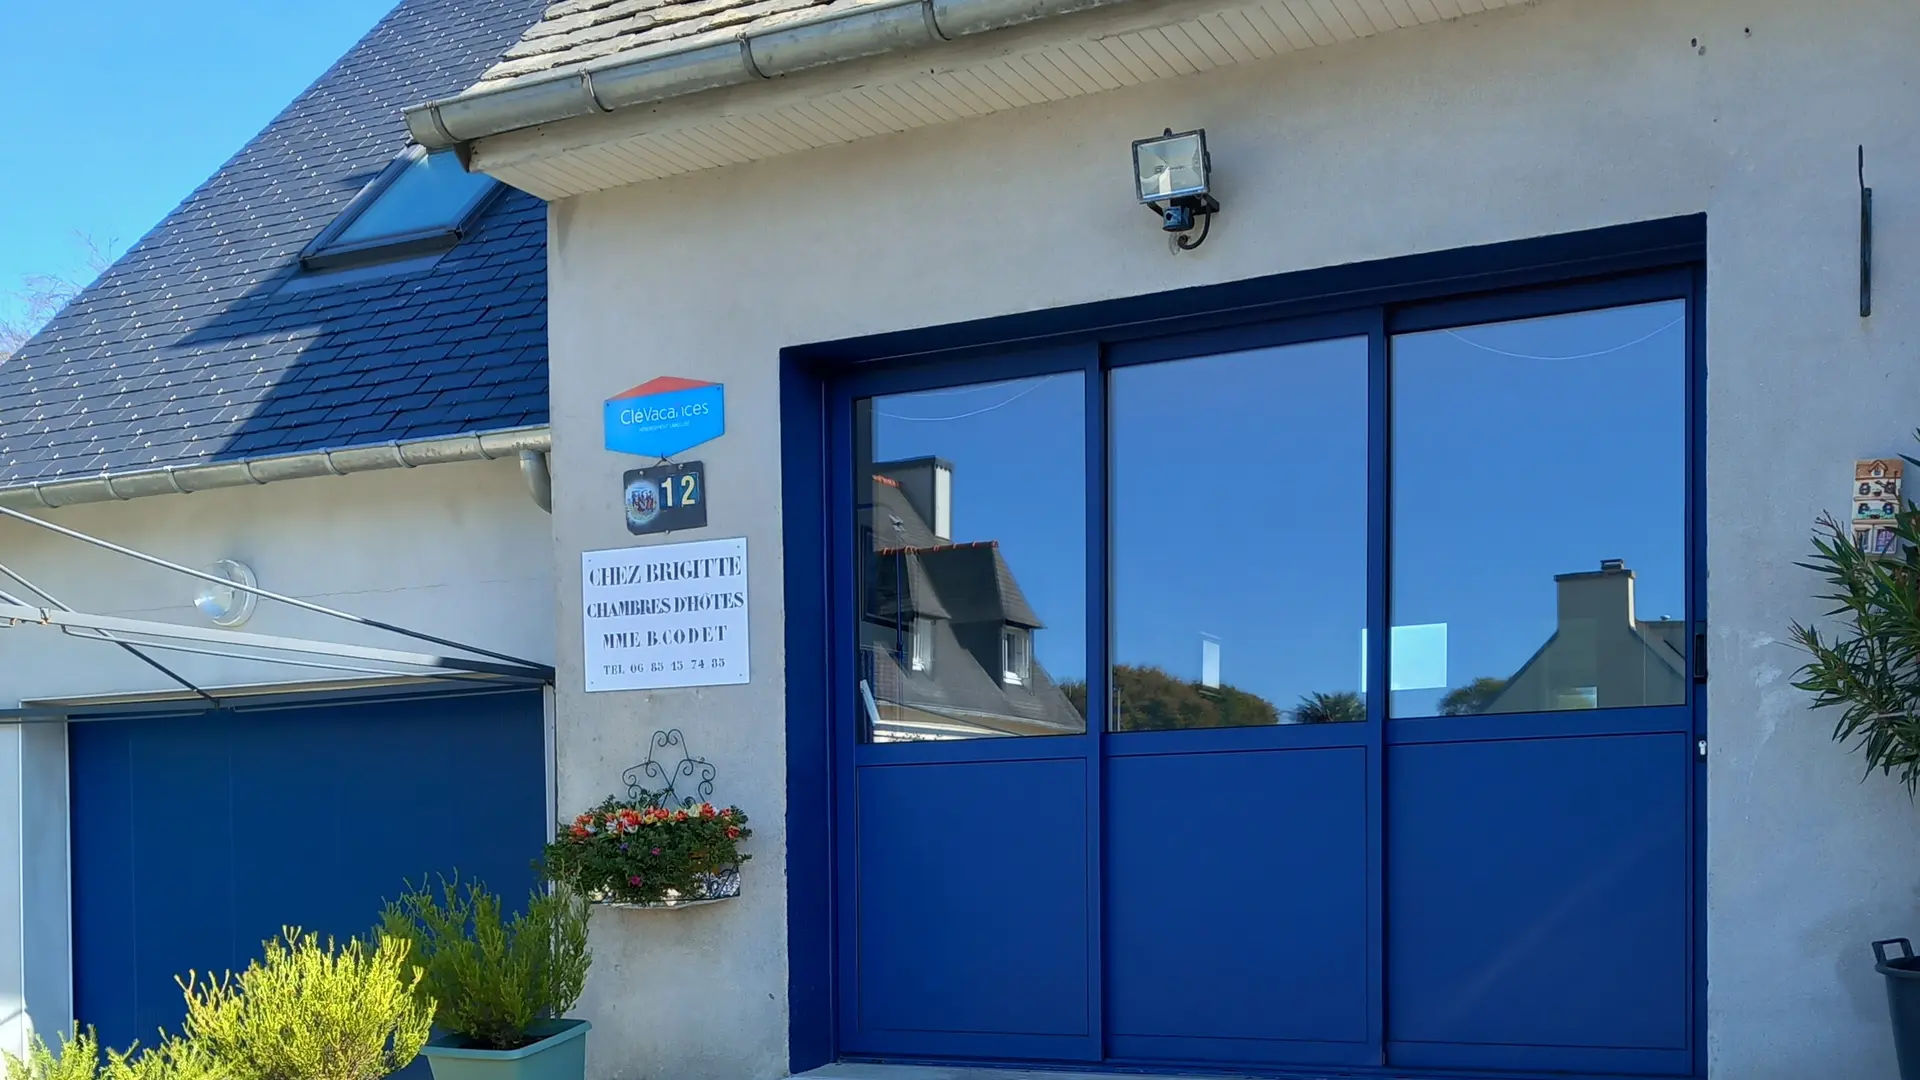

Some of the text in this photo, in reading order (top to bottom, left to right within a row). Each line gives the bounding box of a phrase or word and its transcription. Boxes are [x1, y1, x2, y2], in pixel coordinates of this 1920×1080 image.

[661, 475, 696, 507] 12
[589, 556, 742, 587] CHEZ BRIGITTE
[587, 597, 671, 619] CHAMBRES
[603, 631, 641, 650] MME
[630, 663, 644, 674] 06
[691, 659, 705, 670] 74
